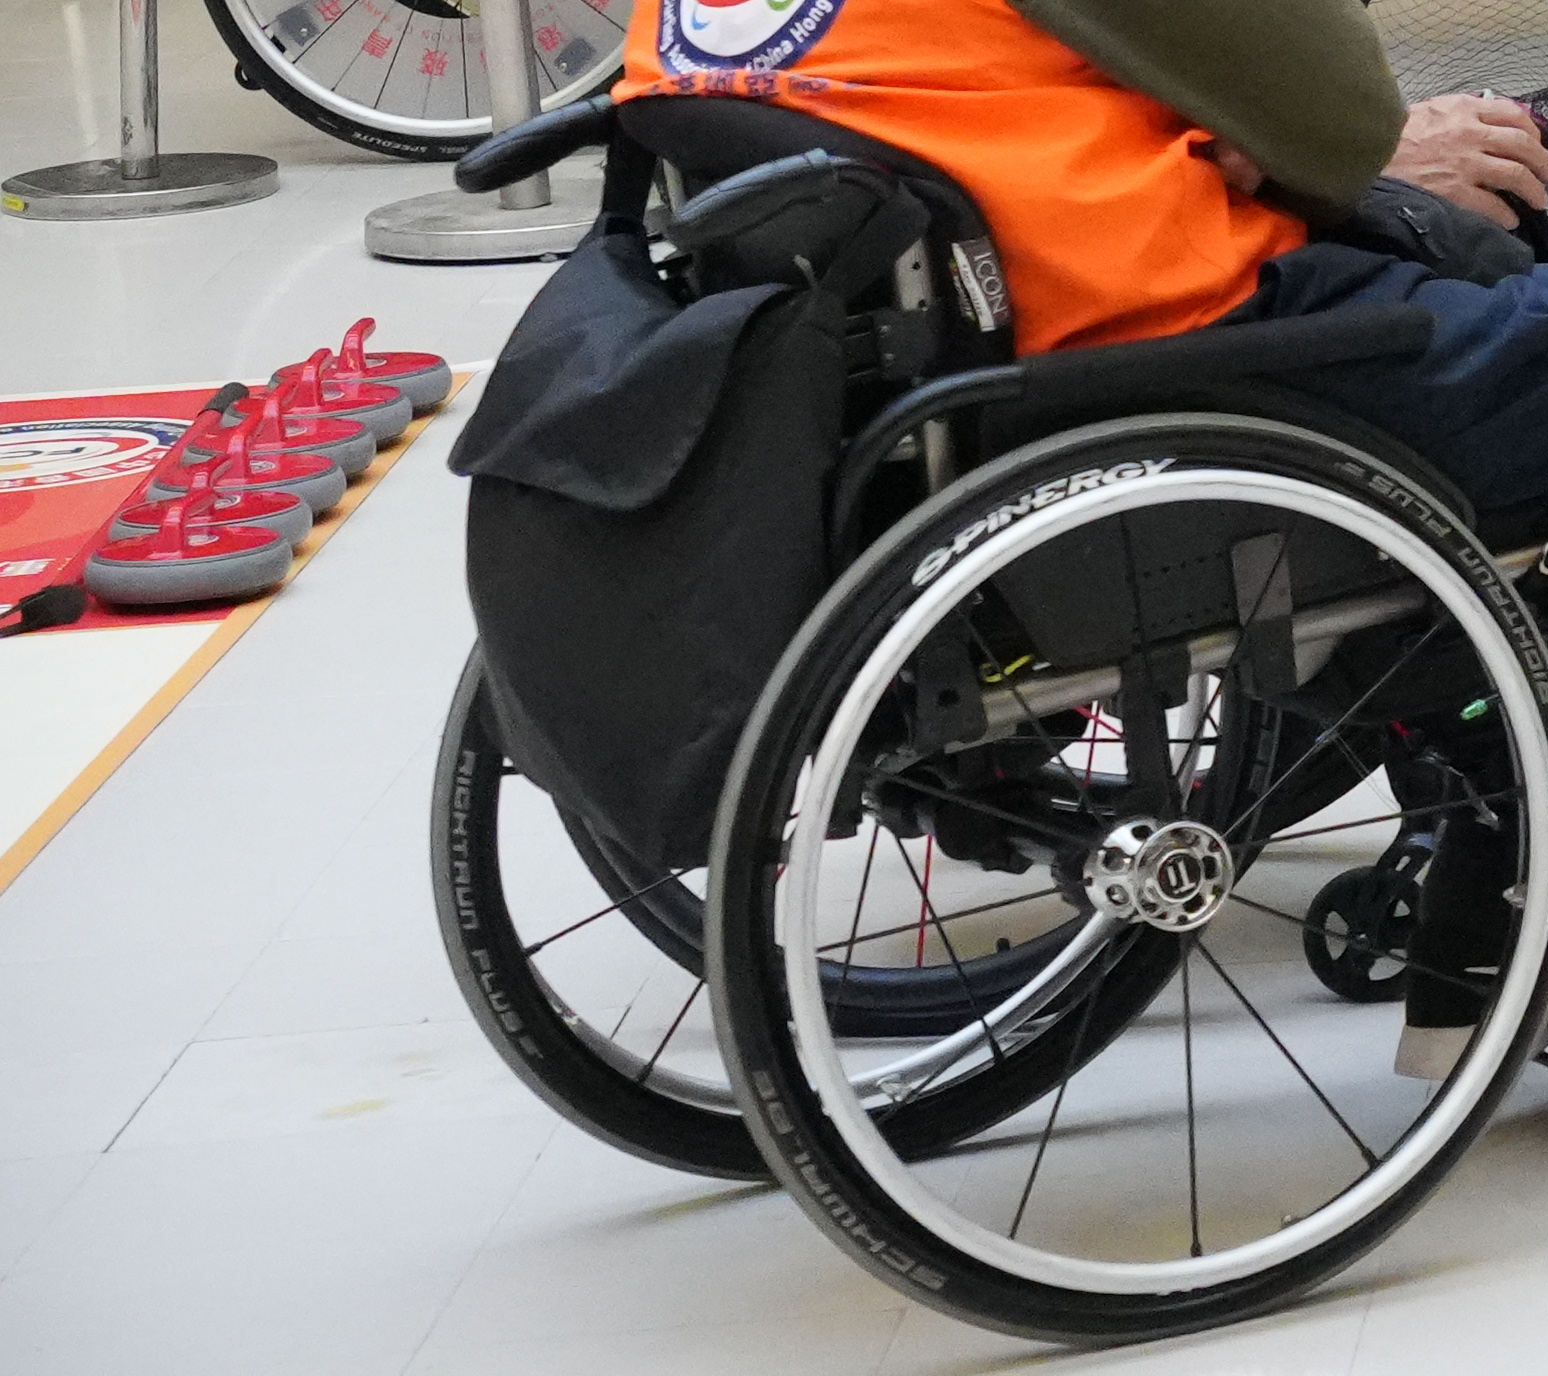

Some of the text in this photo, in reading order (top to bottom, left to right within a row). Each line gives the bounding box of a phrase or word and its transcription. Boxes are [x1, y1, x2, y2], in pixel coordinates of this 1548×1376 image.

[351, 131, 429, 154] SPEEDLITE
[973, 251, 1010, 315] ICON
[1367, 473, 1453, 538] PLUS
[452, 750, 524, 1035] RIGHTRUN PLUS
[750, 1069, 947, 1292] SCHWALBE
